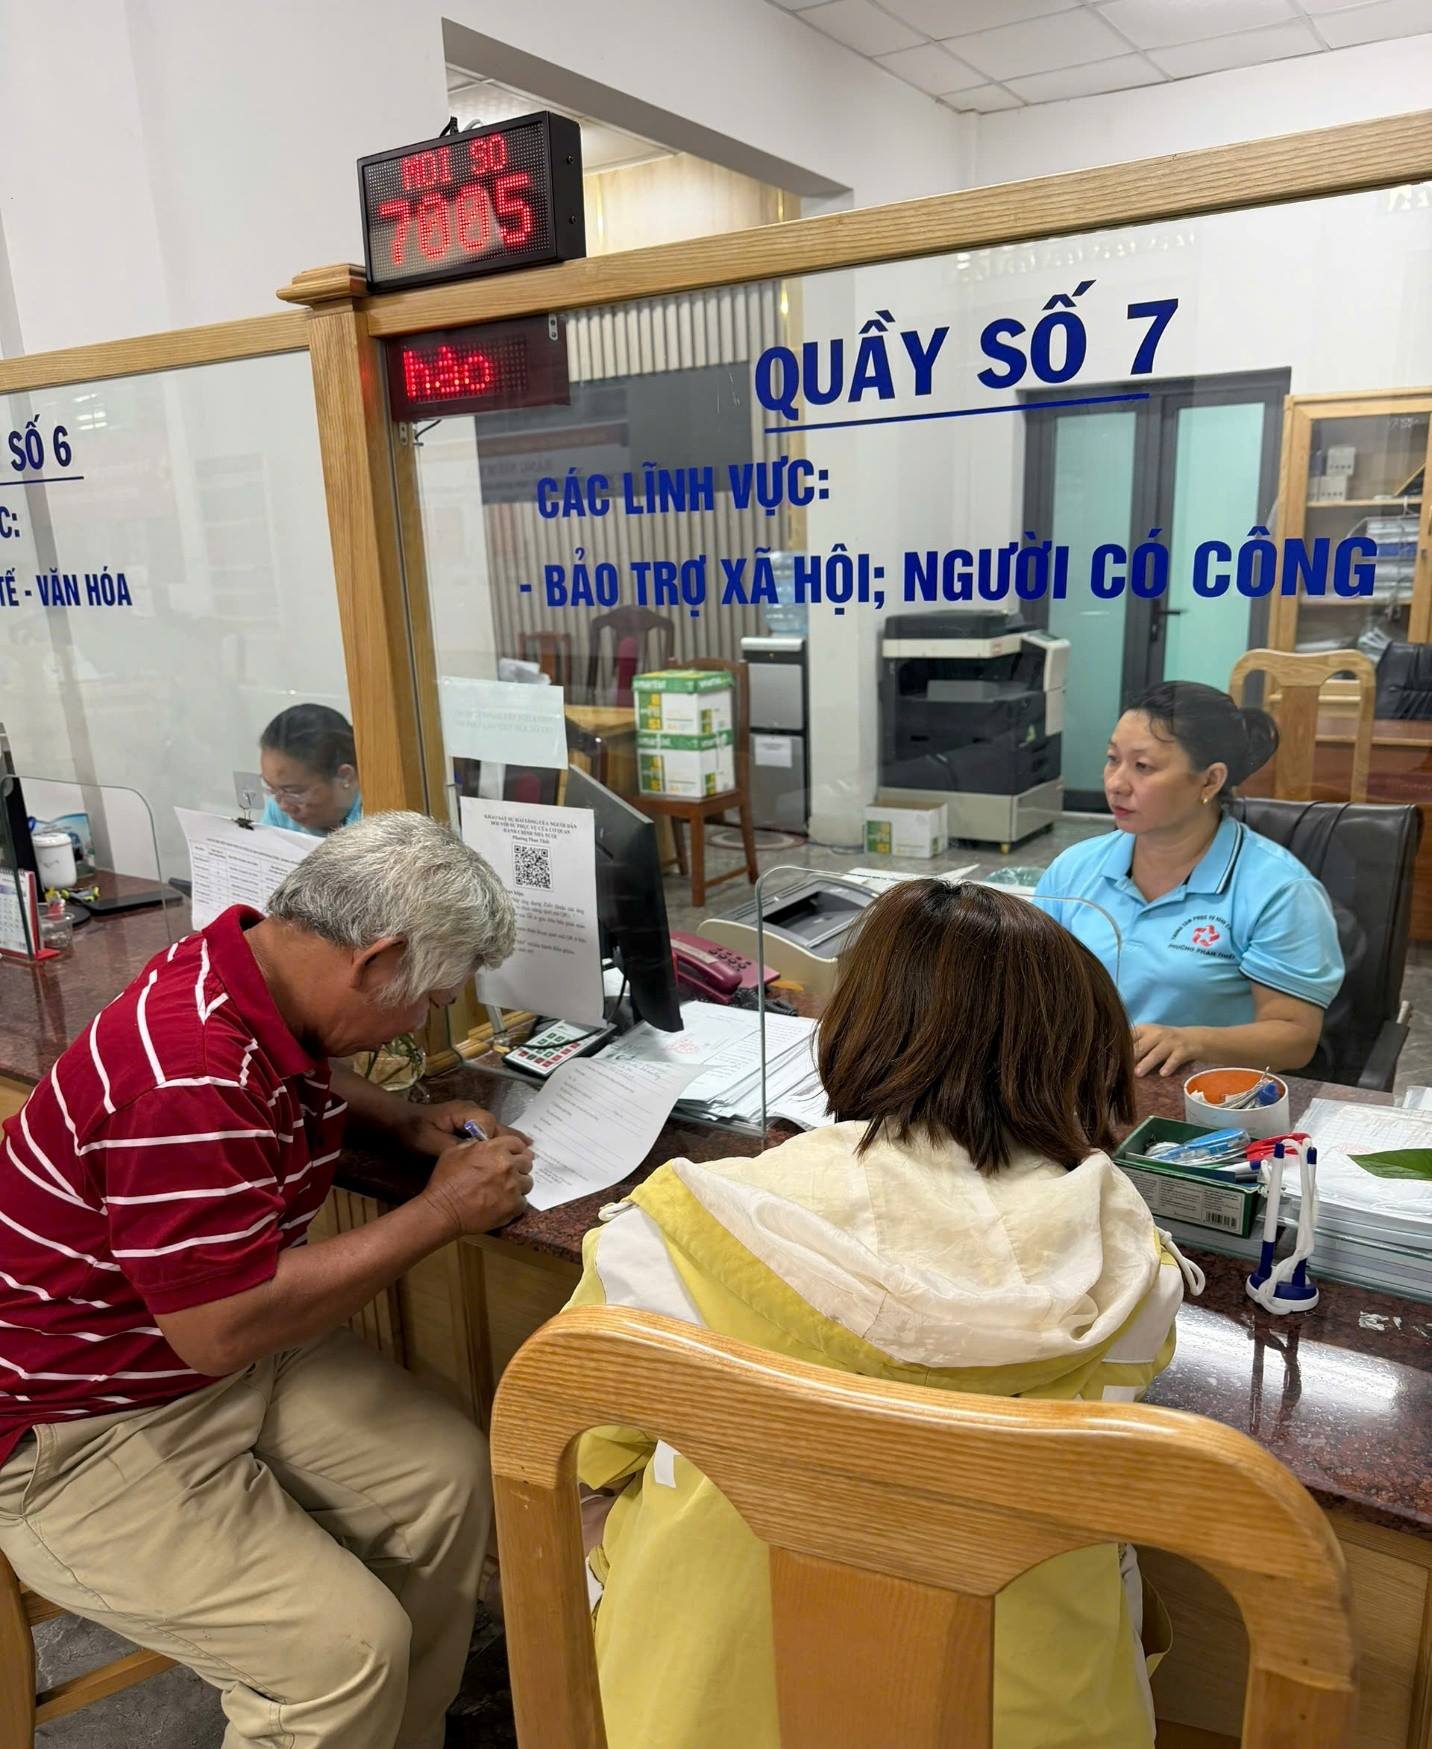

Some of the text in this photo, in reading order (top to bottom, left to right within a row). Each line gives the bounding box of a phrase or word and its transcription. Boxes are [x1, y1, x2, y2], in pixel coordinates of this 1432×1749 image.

[378, 171, 533, 264] 7005
[755, 280, 1179, 421] QUẦY SỐ 7
[8, 414, 72, 471] SỐ 6
[537, 456, 829, 519] CÁC LĨNH VỰC:
[36, 567, 81, 606] VĂN
[85, 566, 133, 606] HÓA
[544, 547, 619, 607] BẢO
[630, 555, 706, 617] TRỢ
[720, 547, 779, 605] XÃ
[794, 543, 885, 615] HỘI;
[904, 531, 1069, 602] NGƯỜI
[1090, 528, 1169, 599] CÓ
[1193, 526, 1377, 598] CÔNG
